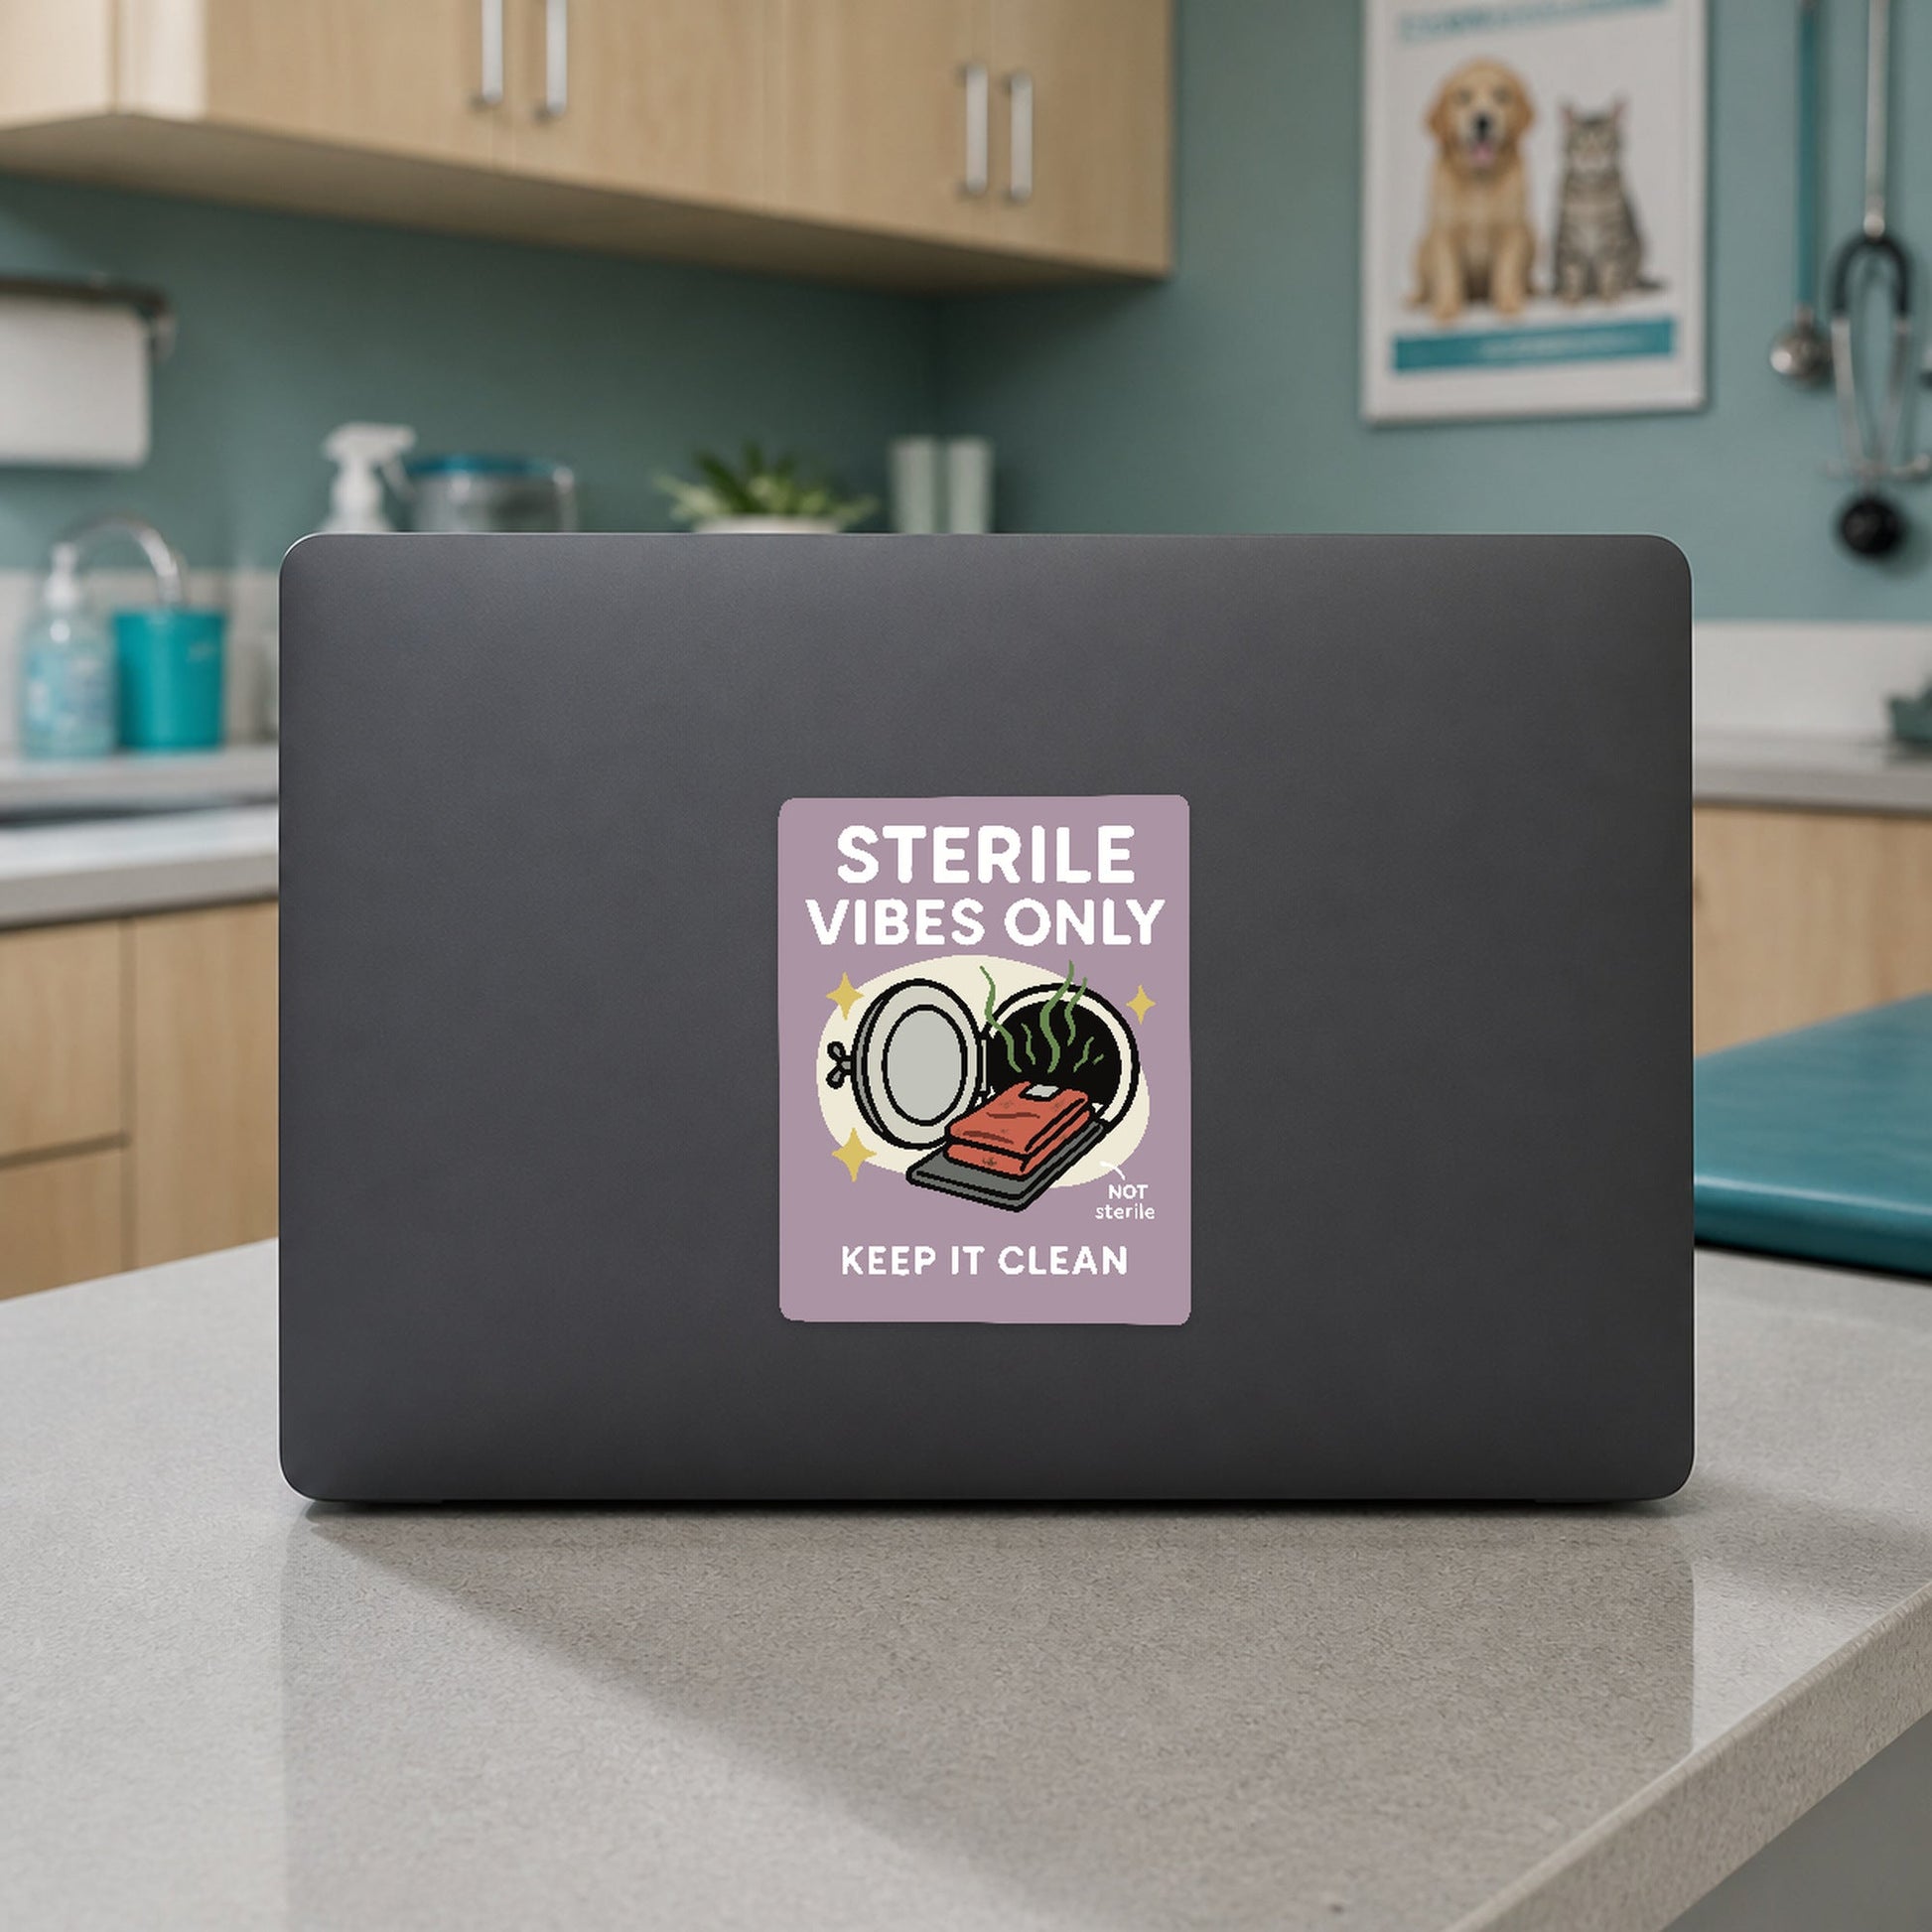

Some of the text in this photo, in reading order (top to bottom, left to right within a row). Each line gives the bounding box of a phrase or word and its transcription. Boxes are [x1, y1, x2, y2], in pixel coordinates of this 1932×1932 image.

[837, 825, 1135, 884] STERILE
[805, 897, 1166, 947] VIBES ONLY
[1108, 1183, 1149, 1200] NOT
[1095, 1202, 1156, 1220] sterile
[842, 1245, 1127, 1276] KEEP IT CLEAN
